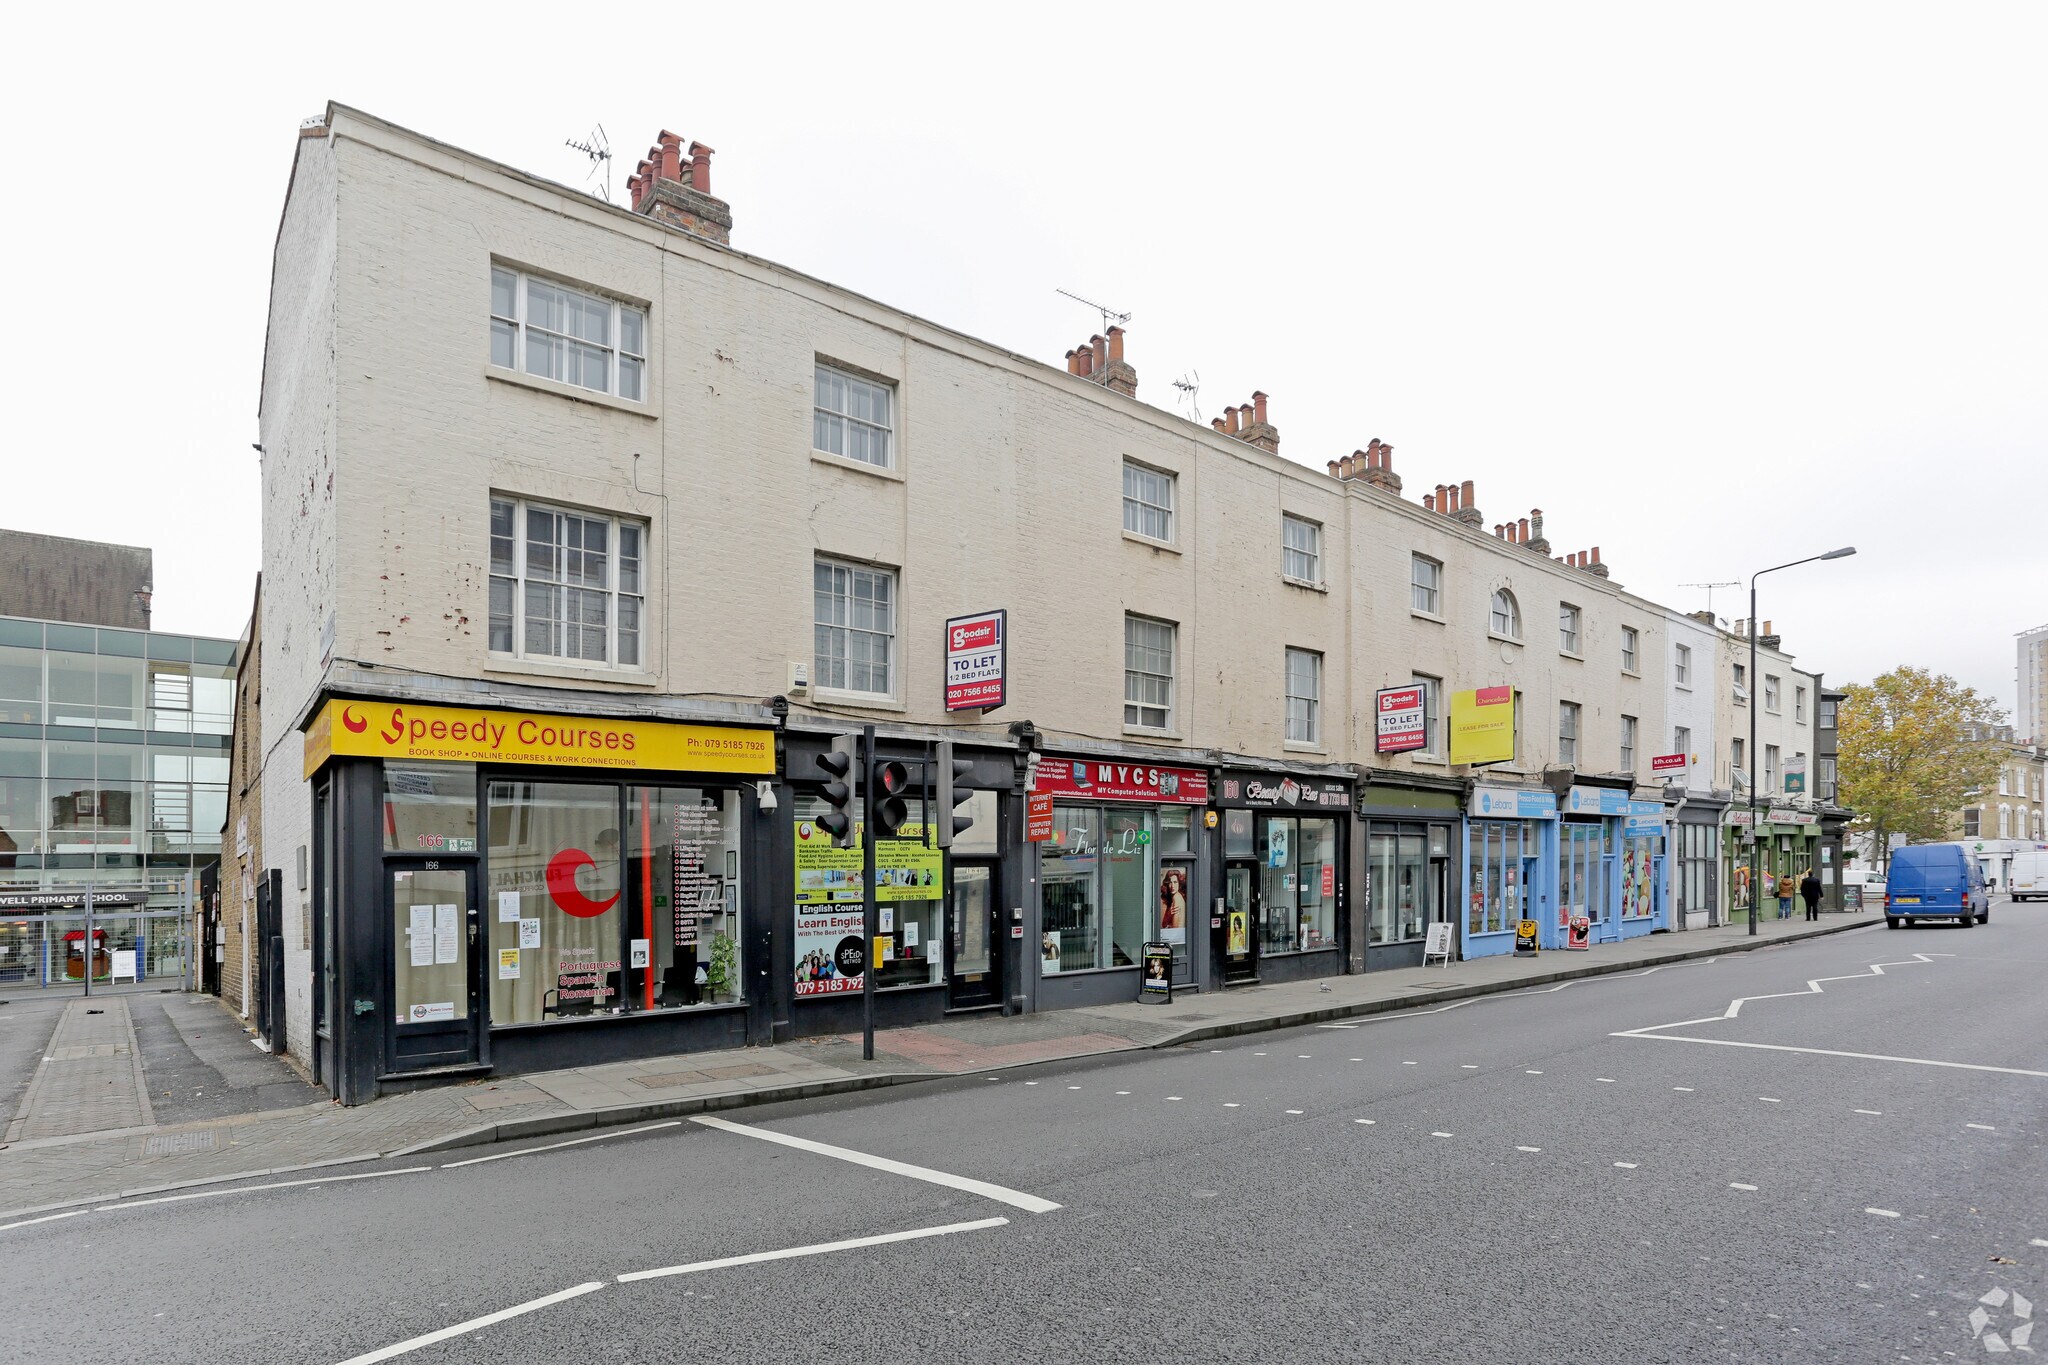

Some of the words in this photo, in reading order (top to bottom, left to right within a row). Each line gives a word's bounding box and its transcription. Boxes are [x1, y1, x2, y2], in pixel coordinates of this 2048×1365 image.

[953, 626, 991, 648] goodsir
[953, 660, 970, 671] TO
[974, 656, 996, 668] LET
[962, 672, 976, 680] BED
[978, 668, 1000, 677] FLATS
[948, 690, 962, 698] 020
[982, 684, 1000, 694] 6455
[1382, 694, 1414, 710] goodsir
[1400, 714, 1419, 724] LET
[380, 708, 506, 750] Speedy
[517, 718, 637, 751] Courses
[687, 738, 702, 748] Ph:
[704, 739, 721, 748] 079
[722, 740, 743, 749] 5185
[745, 740, 766, 750] 7926
[408, 748, 436, 756] BOOK
[438, 750, 462, 758] SHOP
[472, 751, 503, 760] ONLINE
[506, 752, 546, 762] COURSES
[581, 756, 636, 766] CONNECTIONS
[1654, 756, 1682, 764] kfh.co.uk
[1029, 793, 1051, 802] INTERNET
[1107, 788, 1134, 796] Computer
[1135, 789, 1158, 797] Solution
[1492, 798, 1512, 810] Lebara
[1029, 820, 1051, 828] COMPUTER
[1030, 828, 1050, 836] REPAIR
[417, 833, 443, 847] 166
[1068, 828, 1096, 855] Flor
[1103, 845, 1114, 854] de
[1118, 828, 1141, 855] Liz
[425, 861, 439, 870] 166
[31, 896, 80, 904] PRIMARY
[802, 904, 833, 914] English
[798, 918, 827, 928] Learn
[560, 960, 622, 971] Portuguese
[560, 974, 604, 986] Spanish
[796, 982, 814, 994] 079
[818, 980, 842, 992] 5185
[846, 978, 864, 989] 792
[560, 987, 615, 999] Romanian
